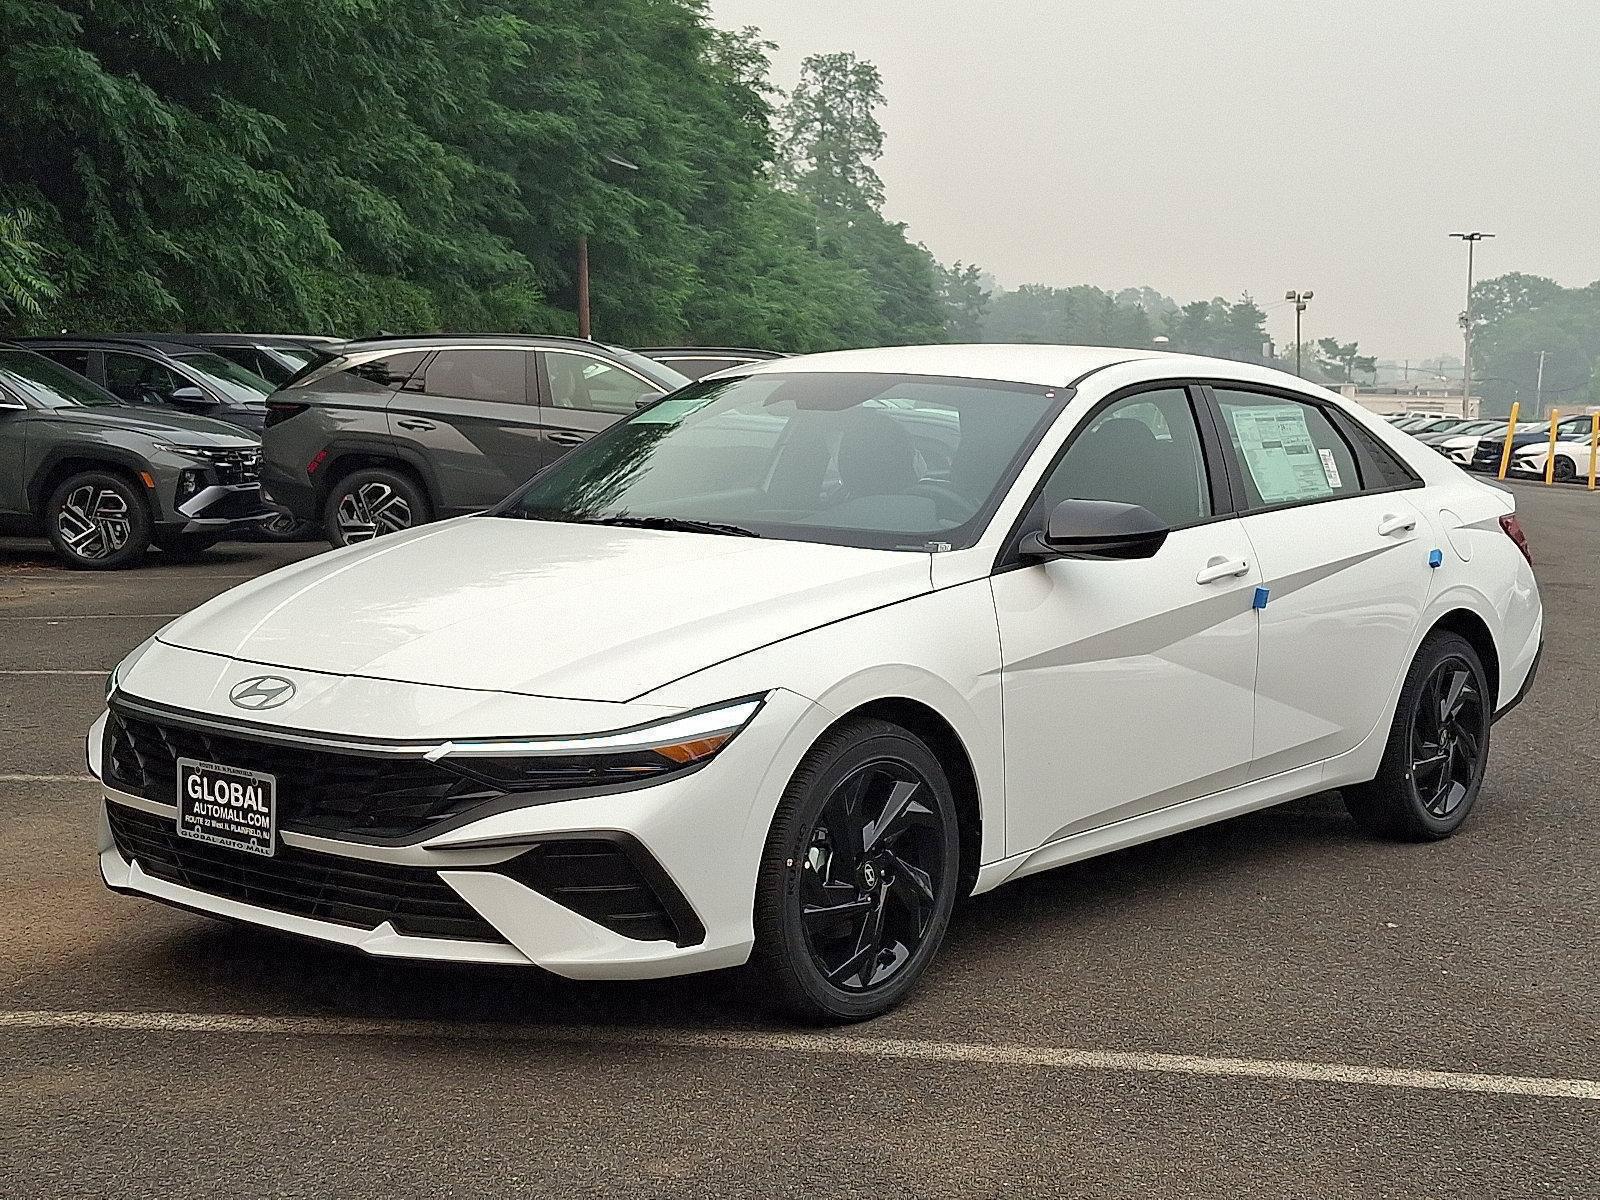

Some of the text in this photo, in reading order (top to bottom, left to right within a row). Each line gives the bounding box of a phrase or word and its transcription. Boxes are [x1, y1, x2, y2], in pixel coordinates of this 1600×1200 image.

[187, 774, 269, 813] GLOBAL
[185, 814, 204, 826] ROUTE
[204, 818, 211, 827] 22
[263, 830, 270, 840] NJ
[193, 801, 270, 829] AUTOMALL.COM
[181, 830, 271, 856] GLOBAL AUTO MALL
